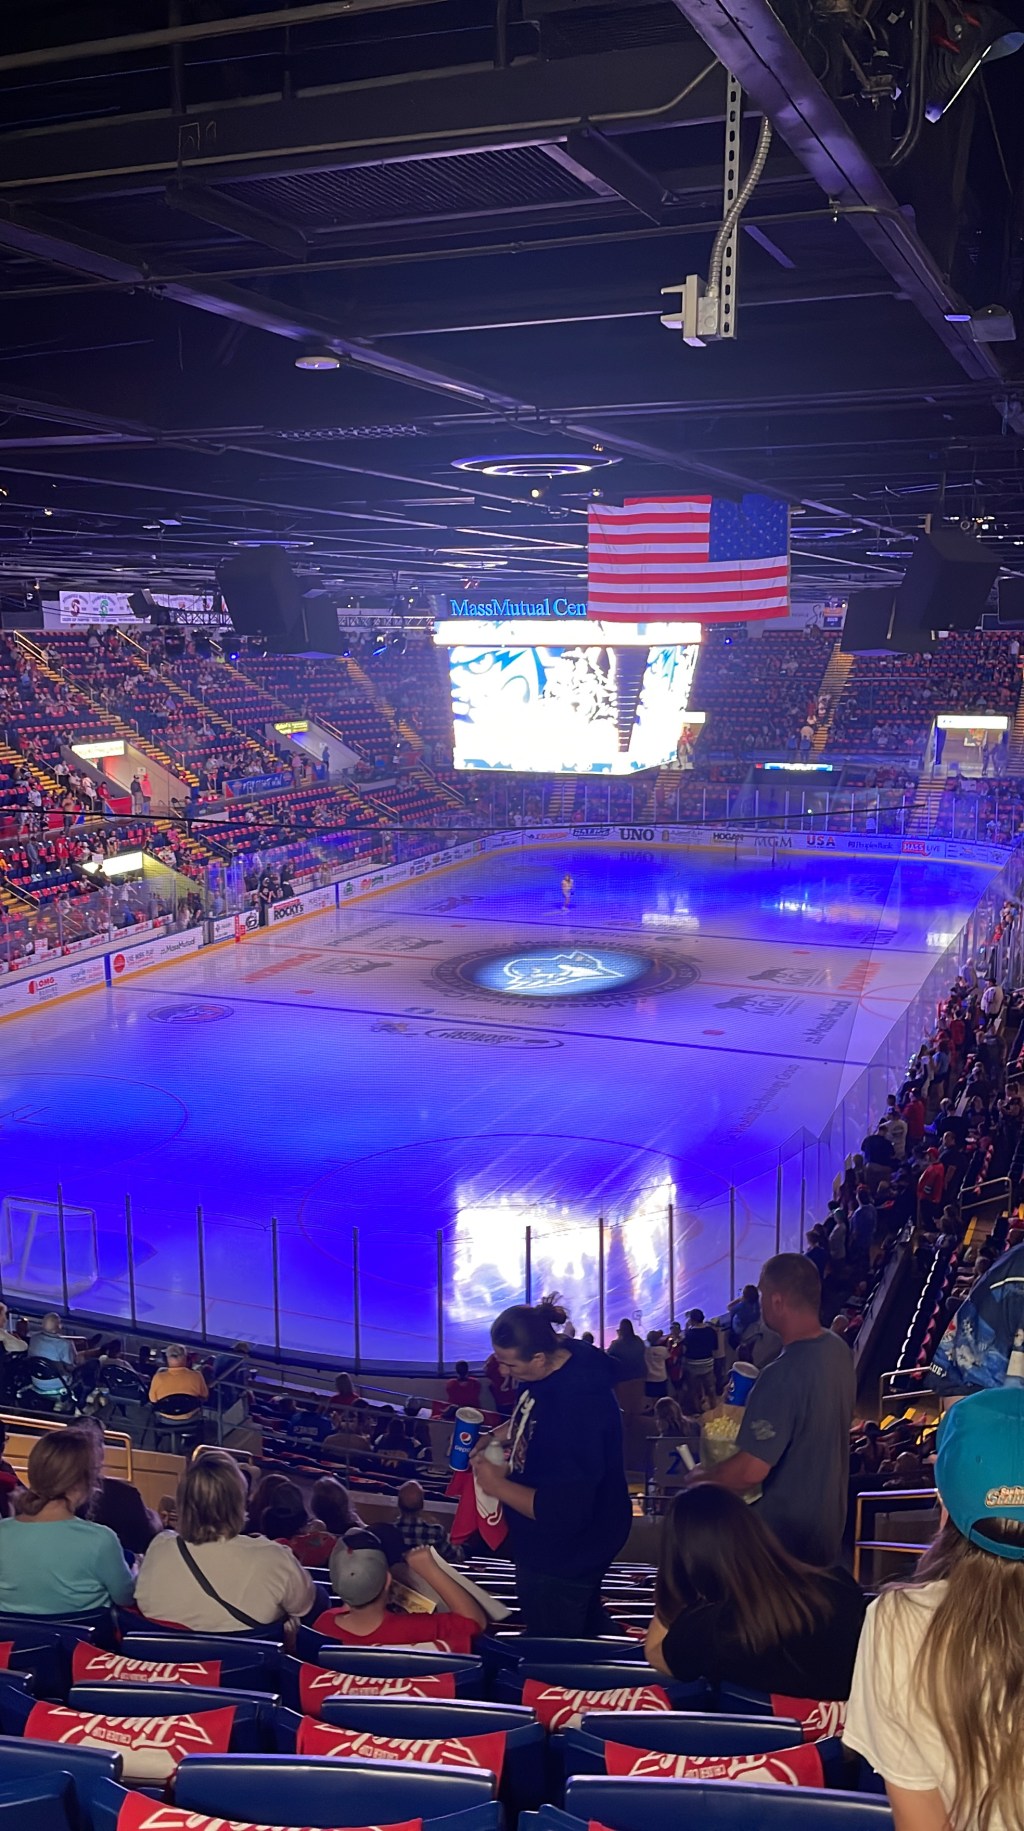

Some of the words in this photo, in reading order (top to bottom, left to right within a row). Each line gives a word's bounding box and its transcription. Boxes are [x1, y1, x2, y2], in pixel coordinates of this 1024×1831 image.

[450, 598, 551, 616] MassMutual
[553, 598, 588, 616] Cen
[619, 828, 655, 841] UNO
[806, 834, 836, 846] USA
[754, 836, 792, 848] MGM
[903, 843, 924, 852] MASS
[38, 977, 55, 987] OMG
